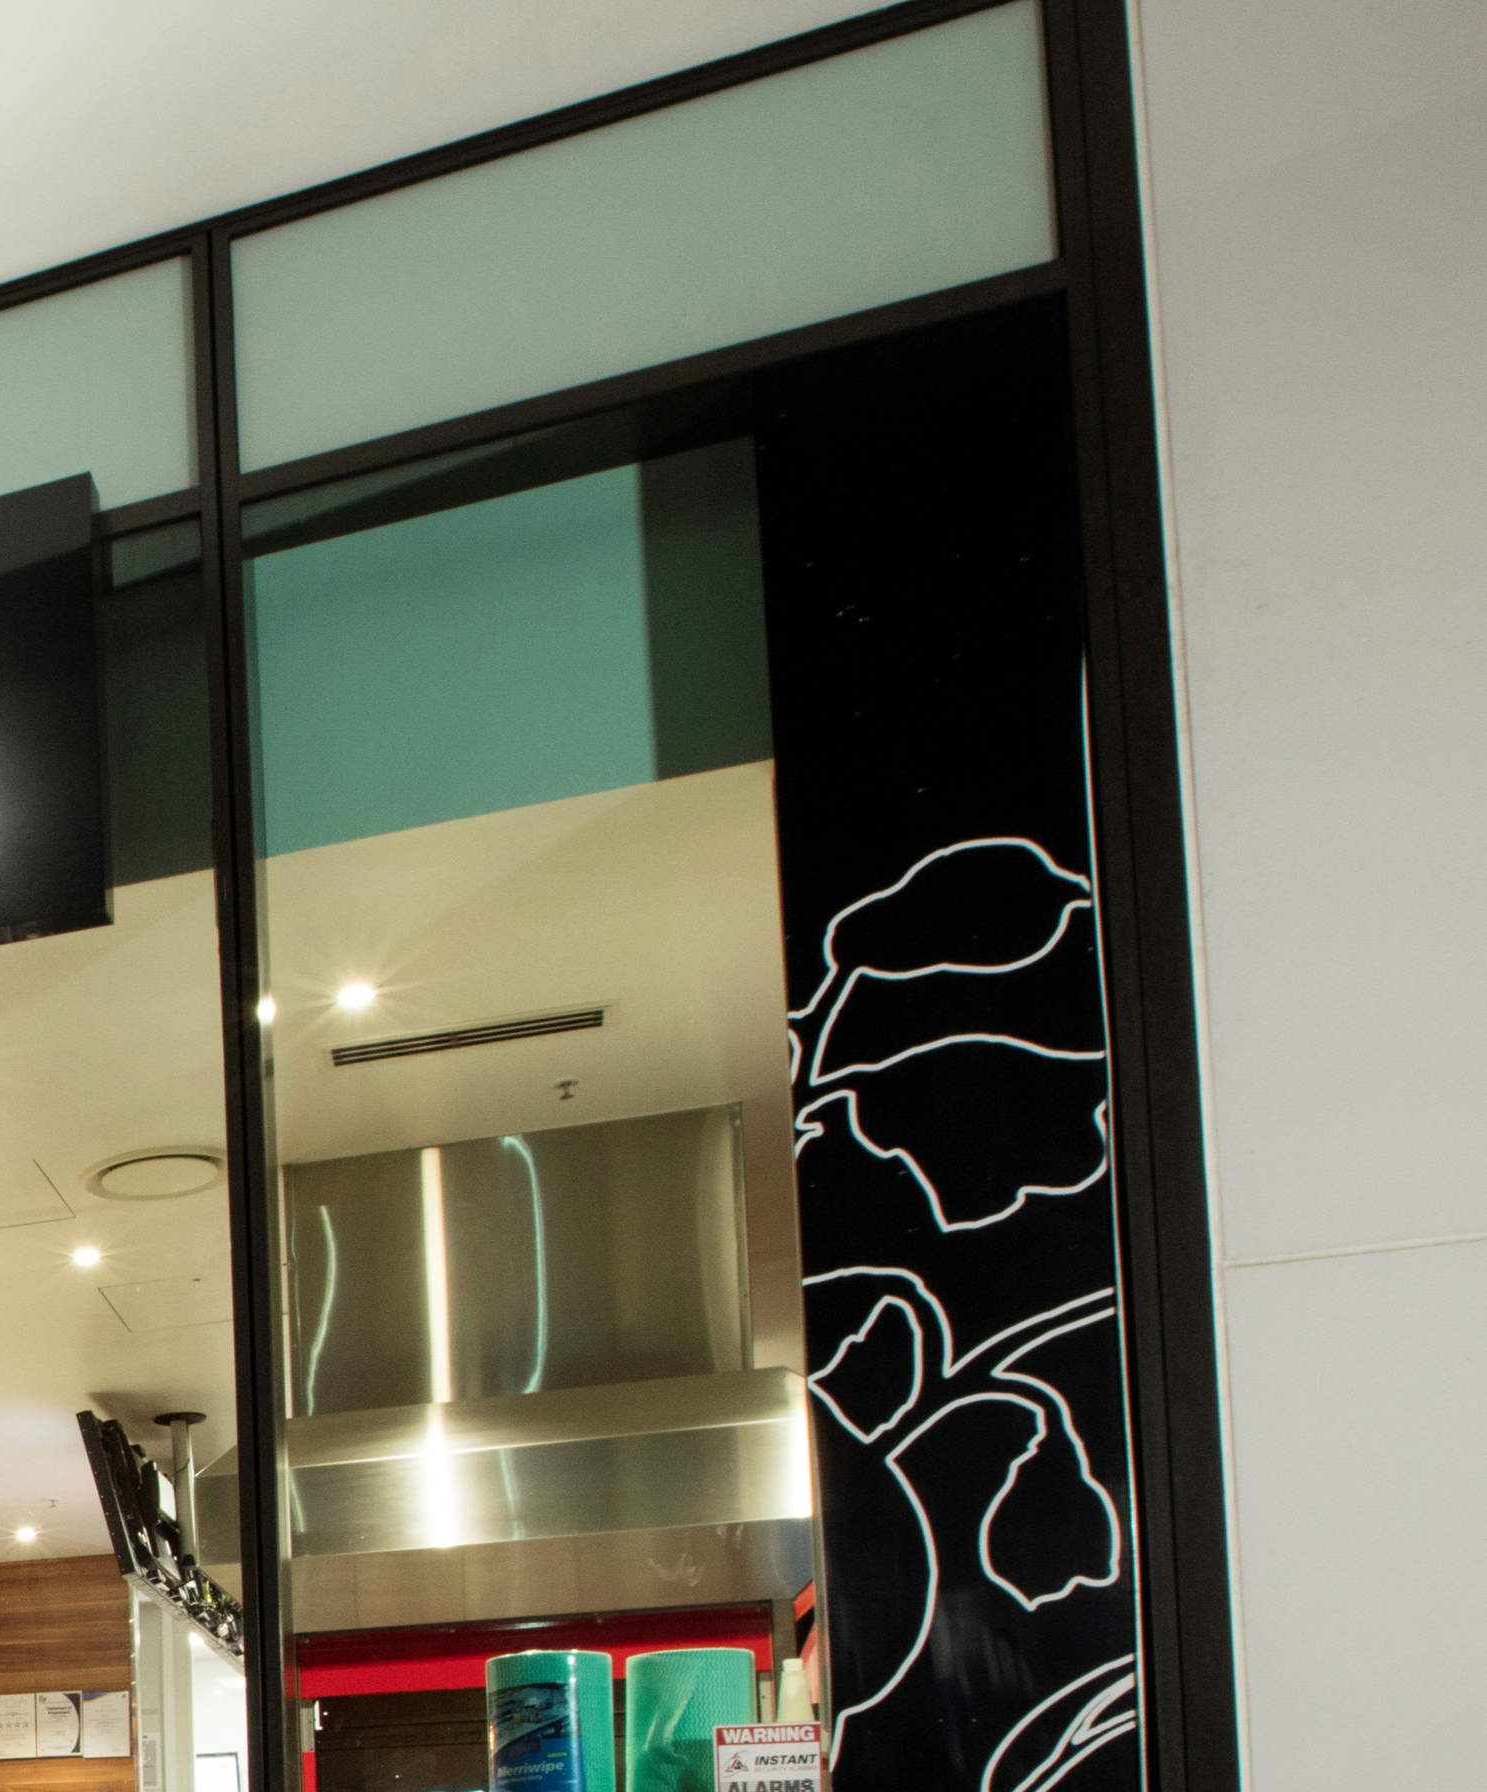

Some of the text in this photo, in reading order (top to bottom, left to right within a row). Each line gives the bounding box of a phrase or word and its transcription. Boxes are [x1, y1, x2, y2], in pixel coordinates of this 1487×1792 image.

[722, 1726, 815, 1744] WARNING
[754, 1753, 818, 1766] INSTANT
[497, 1760, 565, 1778] Merriwipe
